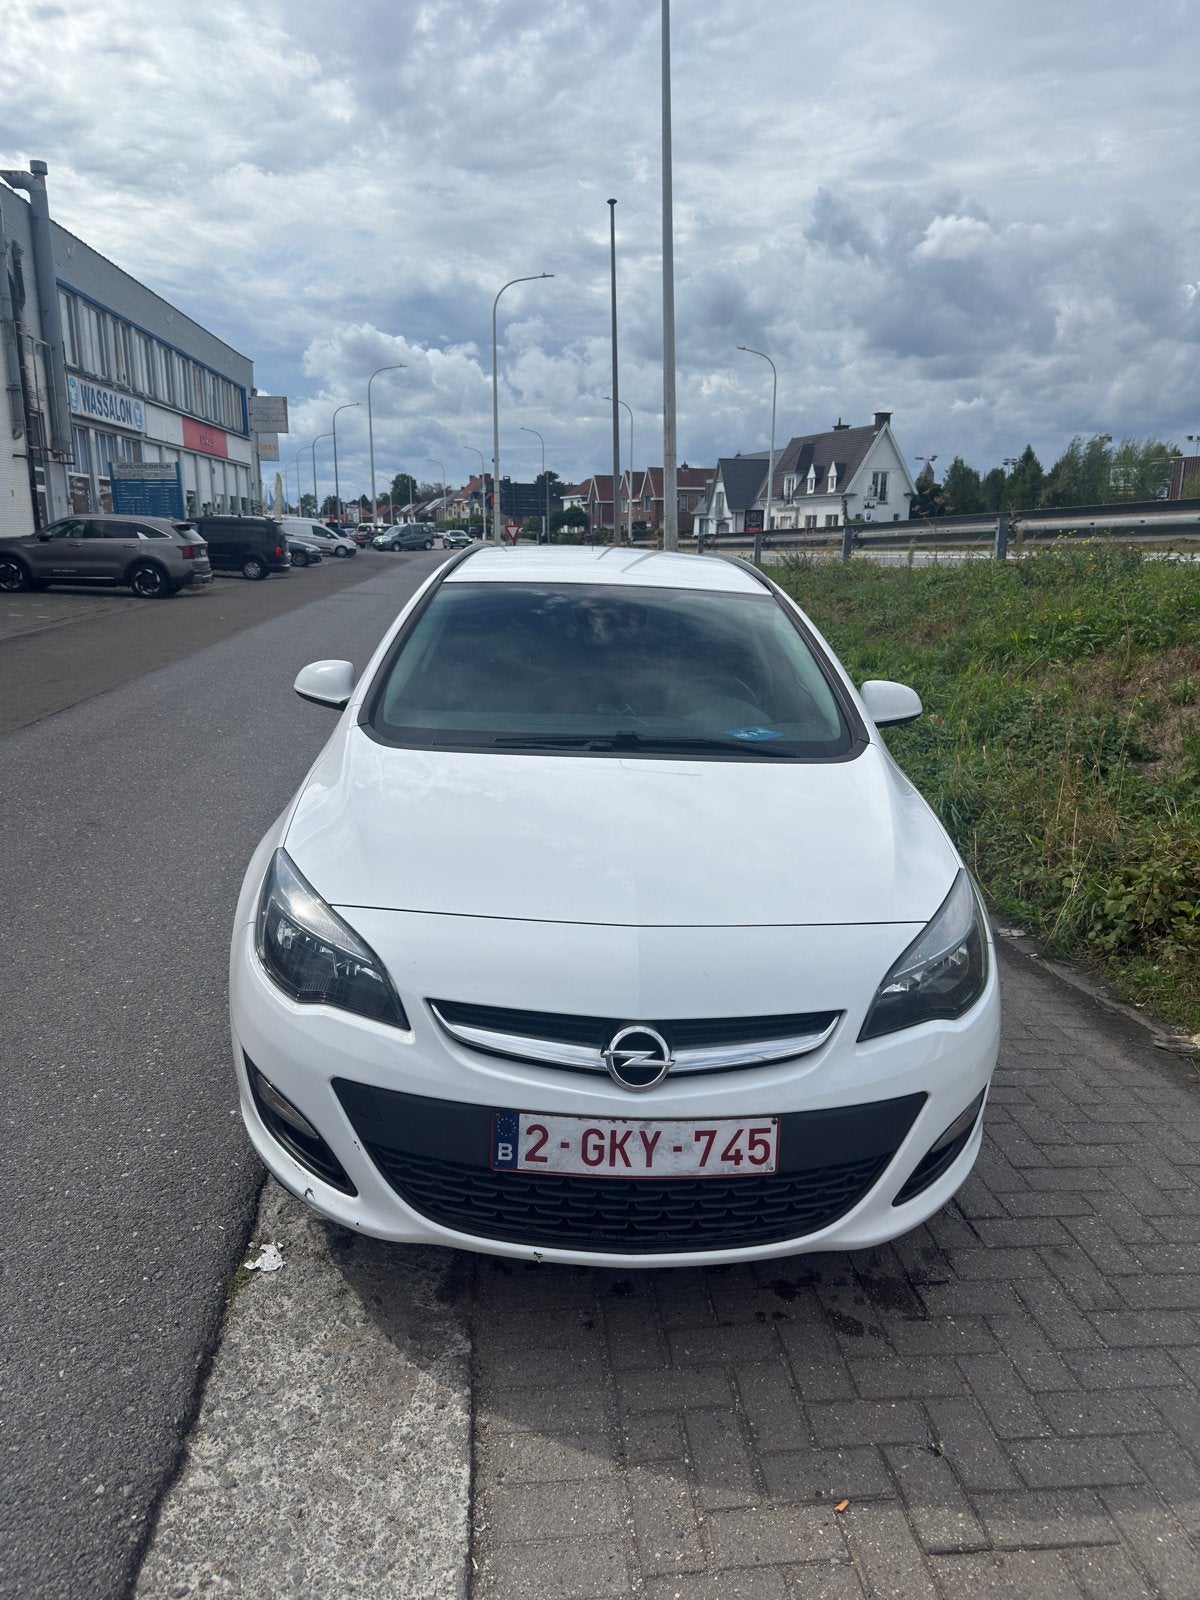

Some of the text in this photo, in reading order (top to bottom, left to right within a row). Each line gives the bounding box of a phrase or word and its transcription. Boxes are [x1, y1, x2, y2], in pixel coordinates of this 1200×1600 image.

[81, 384, 132, 424] WASSALON
[497, 1142, 513, 1161] B
[524, 1124, 772, 1168] 2-GKY-745
